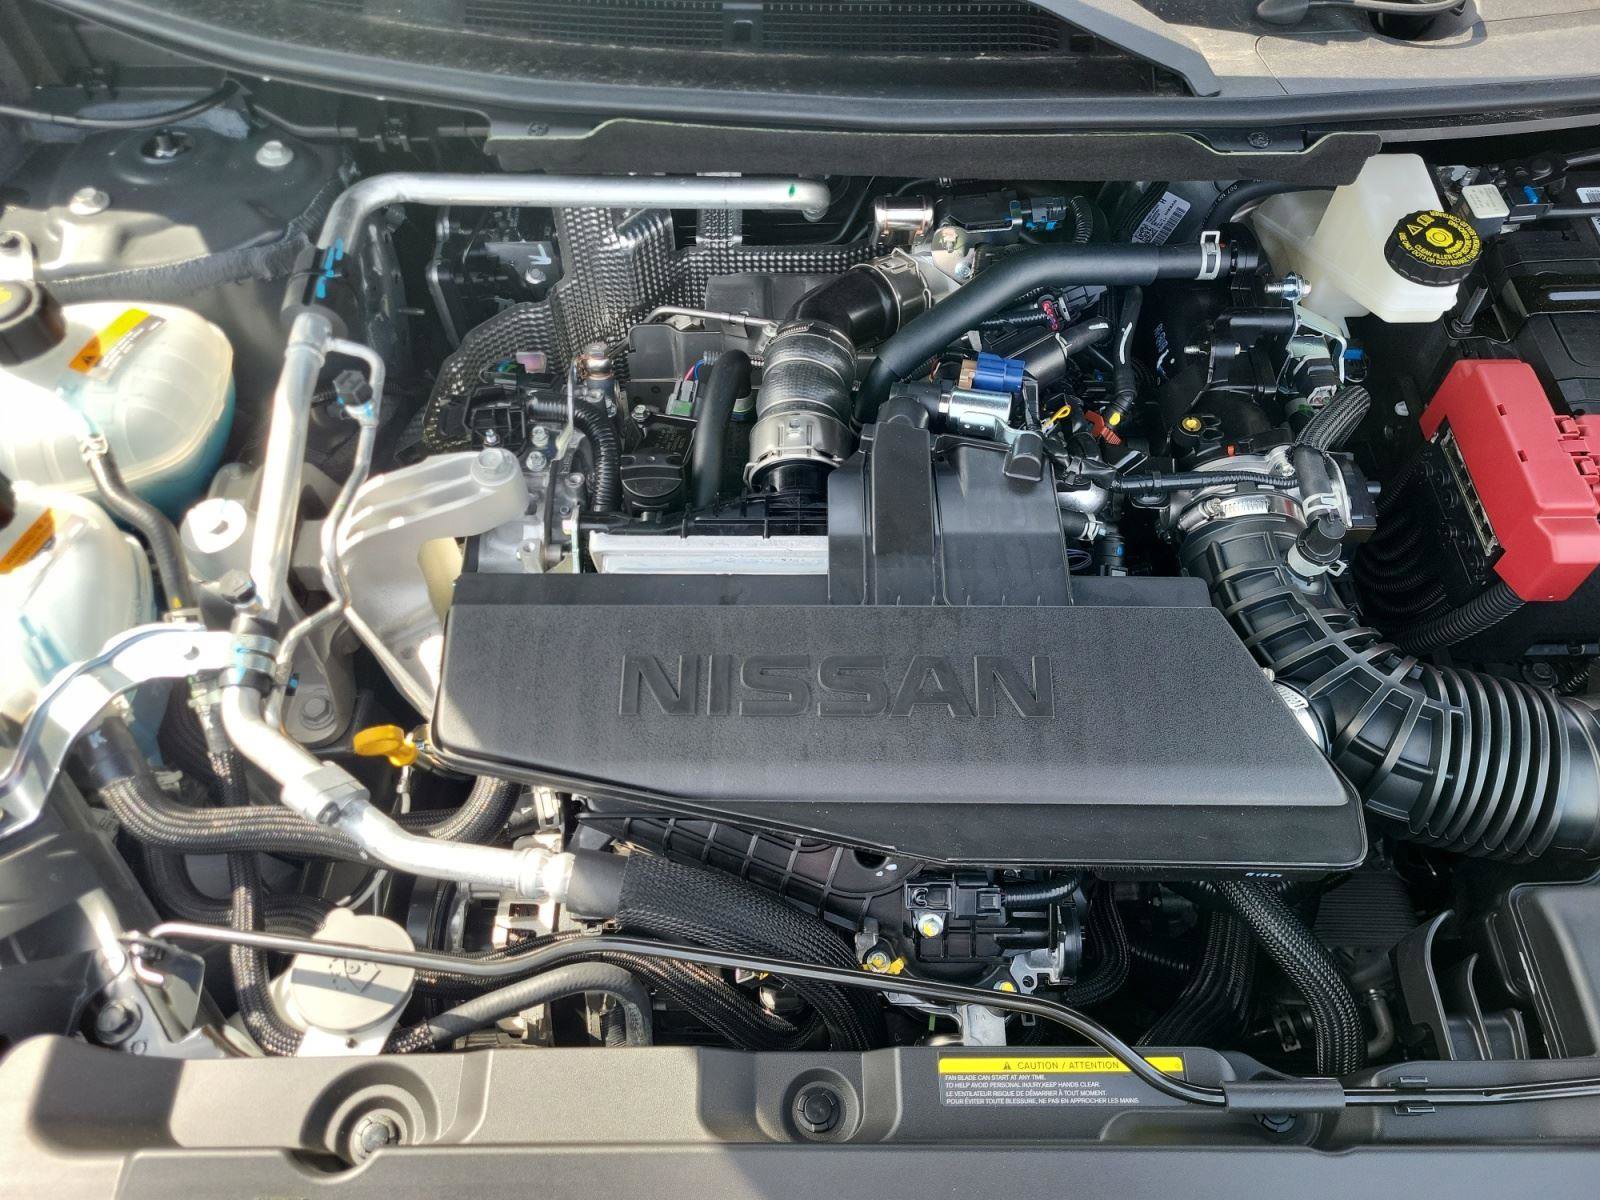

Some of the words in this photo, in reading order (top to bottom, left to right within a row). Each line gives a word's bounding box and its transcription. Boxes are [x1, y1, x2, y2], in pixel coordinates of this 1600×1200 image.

[619, 654, 1055, 718] NISSAN
[1017, 1061, 1058, 1070] CAUTION
[1069, 1061, 1119, 1070] ATTENTION
